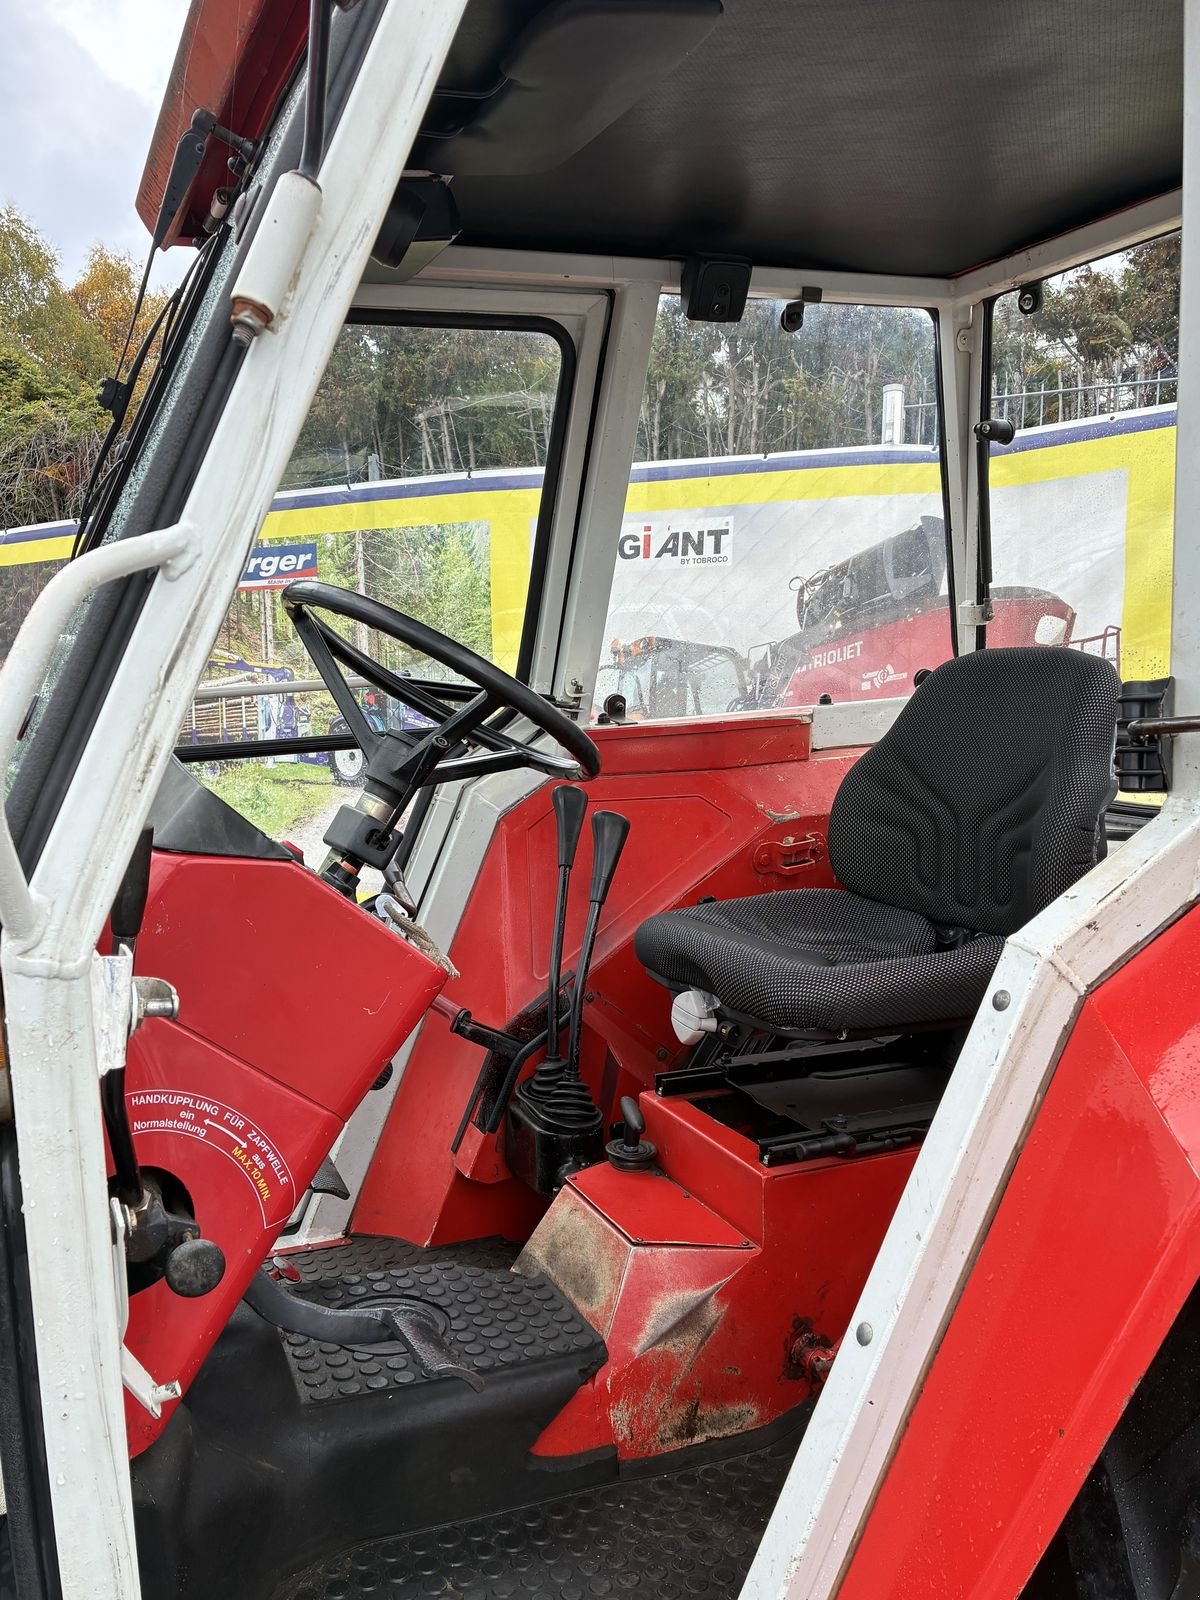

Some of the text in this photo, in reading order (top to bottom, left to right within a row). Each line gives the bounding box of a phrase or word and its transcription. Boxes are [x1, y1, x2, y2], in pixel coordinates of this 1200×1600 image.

[247, 553, 312, 577] rger
[692, 556, 729, 565] TOBROCO
[179, 1110, 195, 1121] ein
[133, 1118, 207, 1137] Normalstellung
[131, 1094, 289, 1185] HANDKUPPLUNG FÜR ZAPFWELLE
[251, 1153, 266, 1170] aus
[231, 1146, 271, 1202] MAX. 10 MIN.
